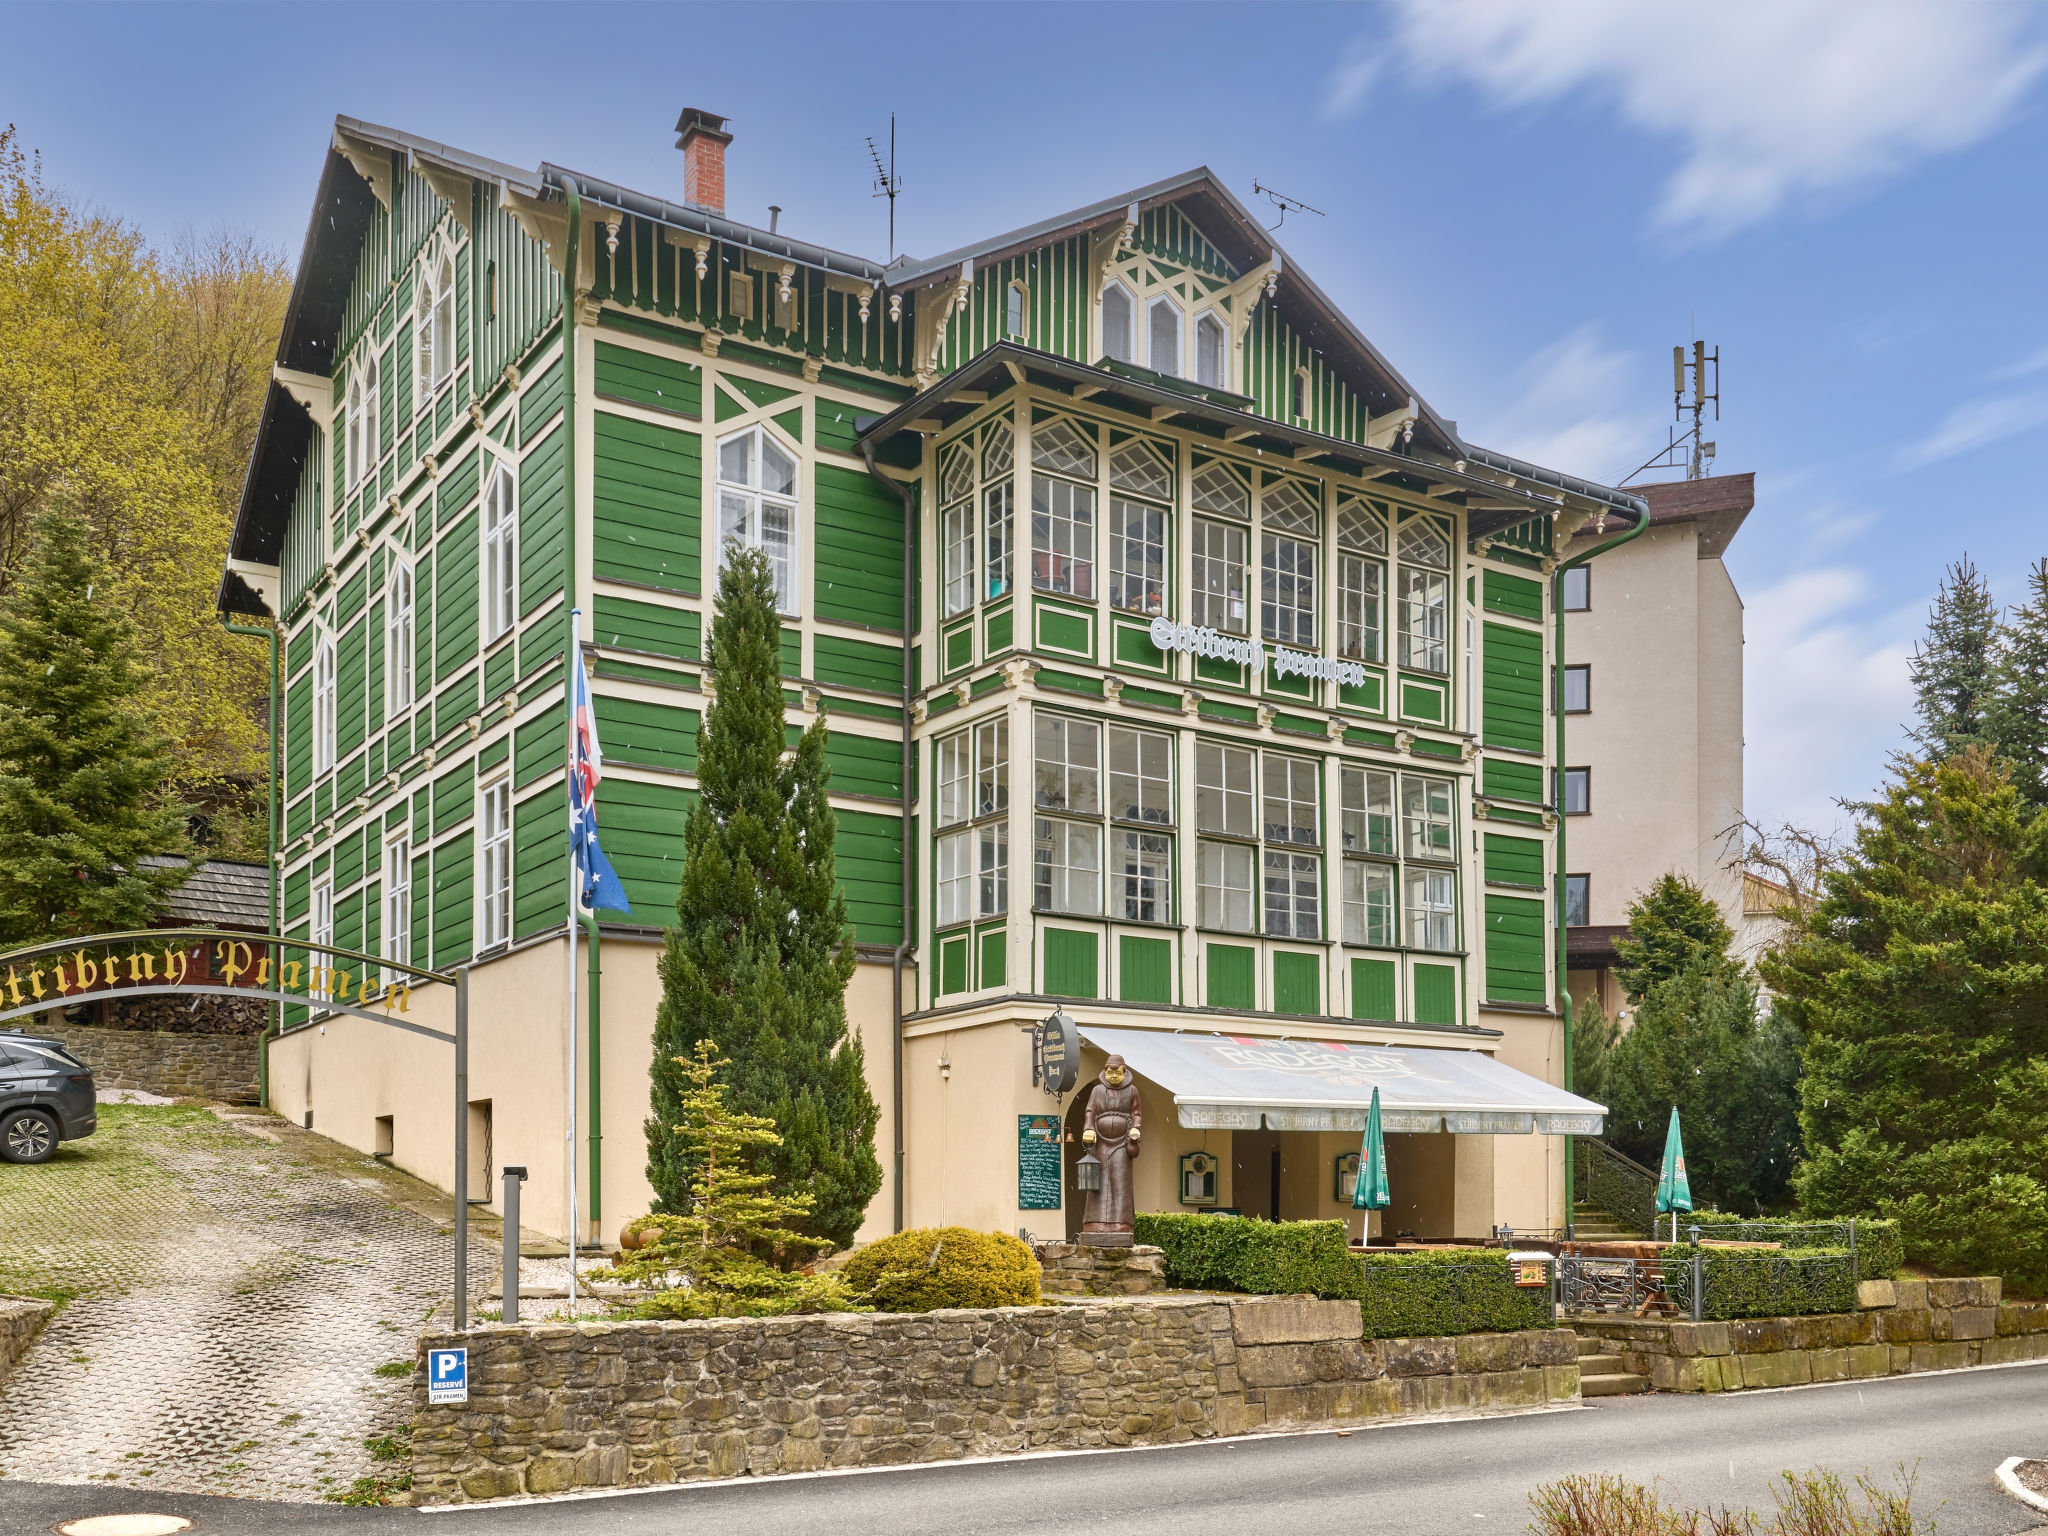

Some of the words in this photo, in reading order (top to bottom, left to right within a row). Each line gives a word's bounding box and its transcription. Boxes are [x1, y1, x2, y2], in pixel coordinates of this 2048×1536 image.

[1274, 644, 1366, 688] pramen
[216, 939, 413, 1014] Pramen
[1192, 1112, 1250, 1128] RADEGAST
[1547, 1119, 1592, 1133] RADEGAST
[438, 1354, 457, 1379] P
[433, 1379, 463, 1389] RESERVÉ
